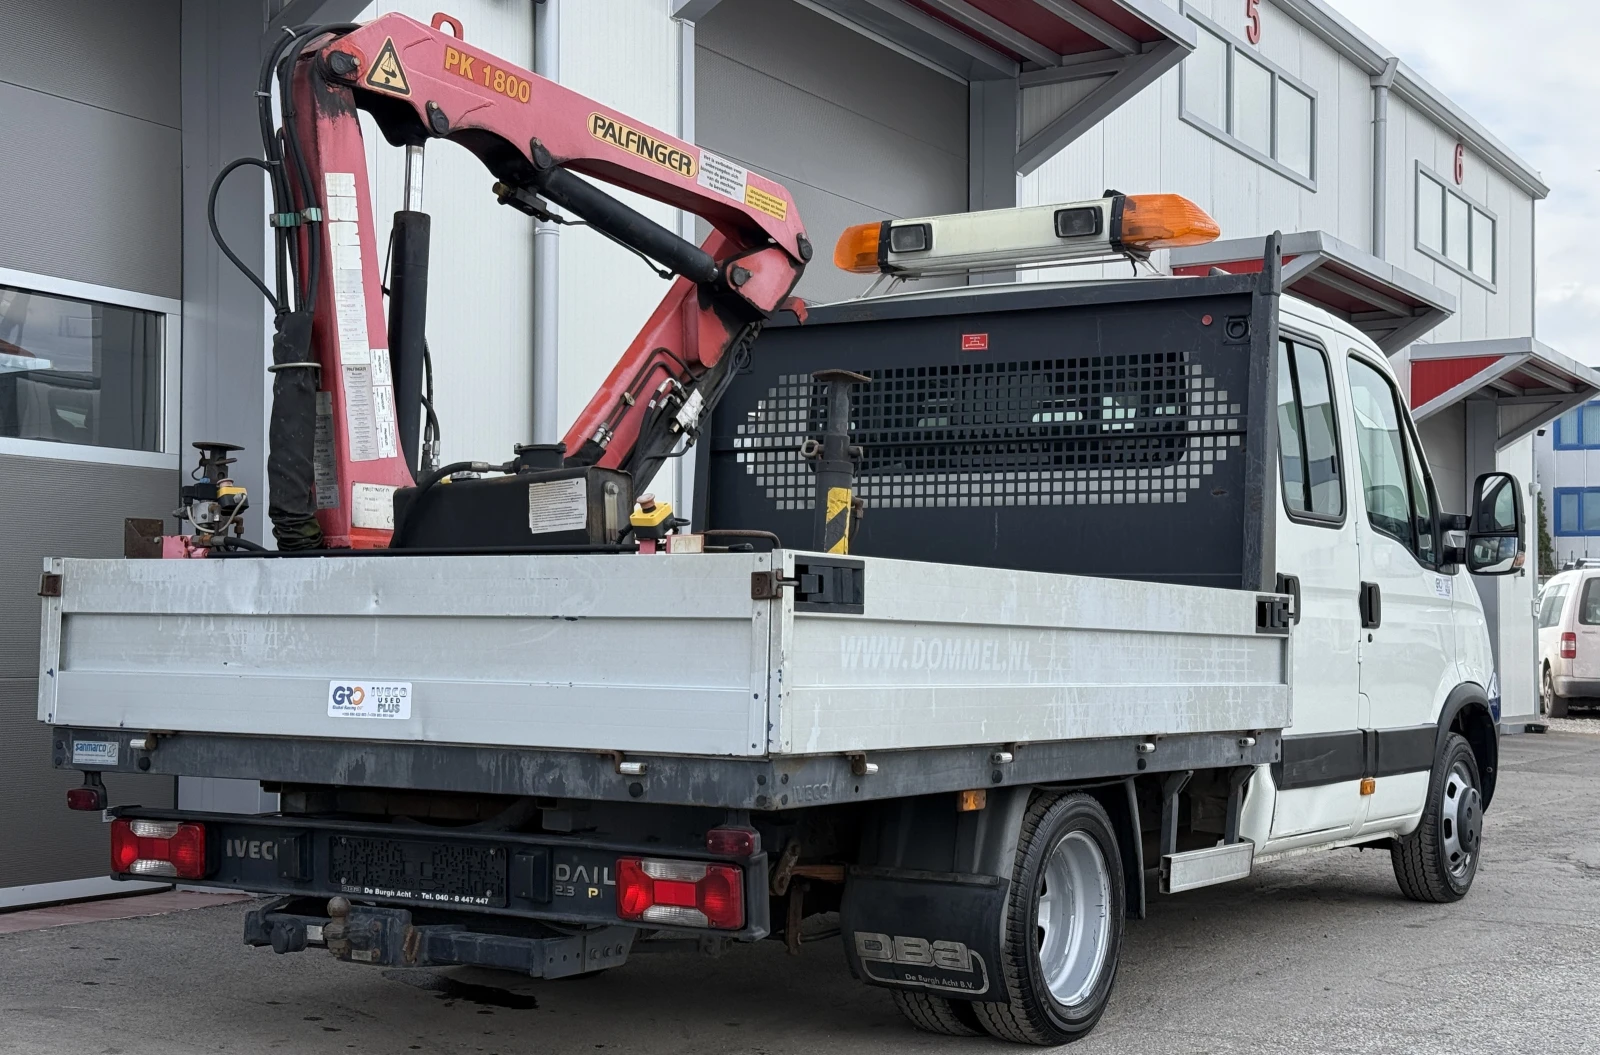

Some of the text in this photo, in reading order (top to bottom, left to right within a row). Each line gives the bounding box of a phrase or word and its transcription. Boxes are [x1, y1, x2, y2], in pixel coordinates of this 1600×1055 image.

[1246, 0, 1261, 45] 5
[444, 46, 530, 103] PK 1800
[593, 115, 691, 175] PALFINGER
[1454, 143, 1464, 185] 6
[332, 685, 365, 705] GRO
[371, 686, 407, 697] IVECO
[377, 703, 401, 714] PLUS
[555, 863, 617, 886] DAIL
[364, 886, 374, 895] De
[375, 887, 395, 897] Burgh
[396, 889, 412, 898] Acht
[421, 891, 434, 900] Tel.
[435, 893, 449, 901] 040
[461, 895, 474, 903] 447
[475, 897, 489, 905] 447
[905, 973, 975, 989] De Burgh Acht B.V.
